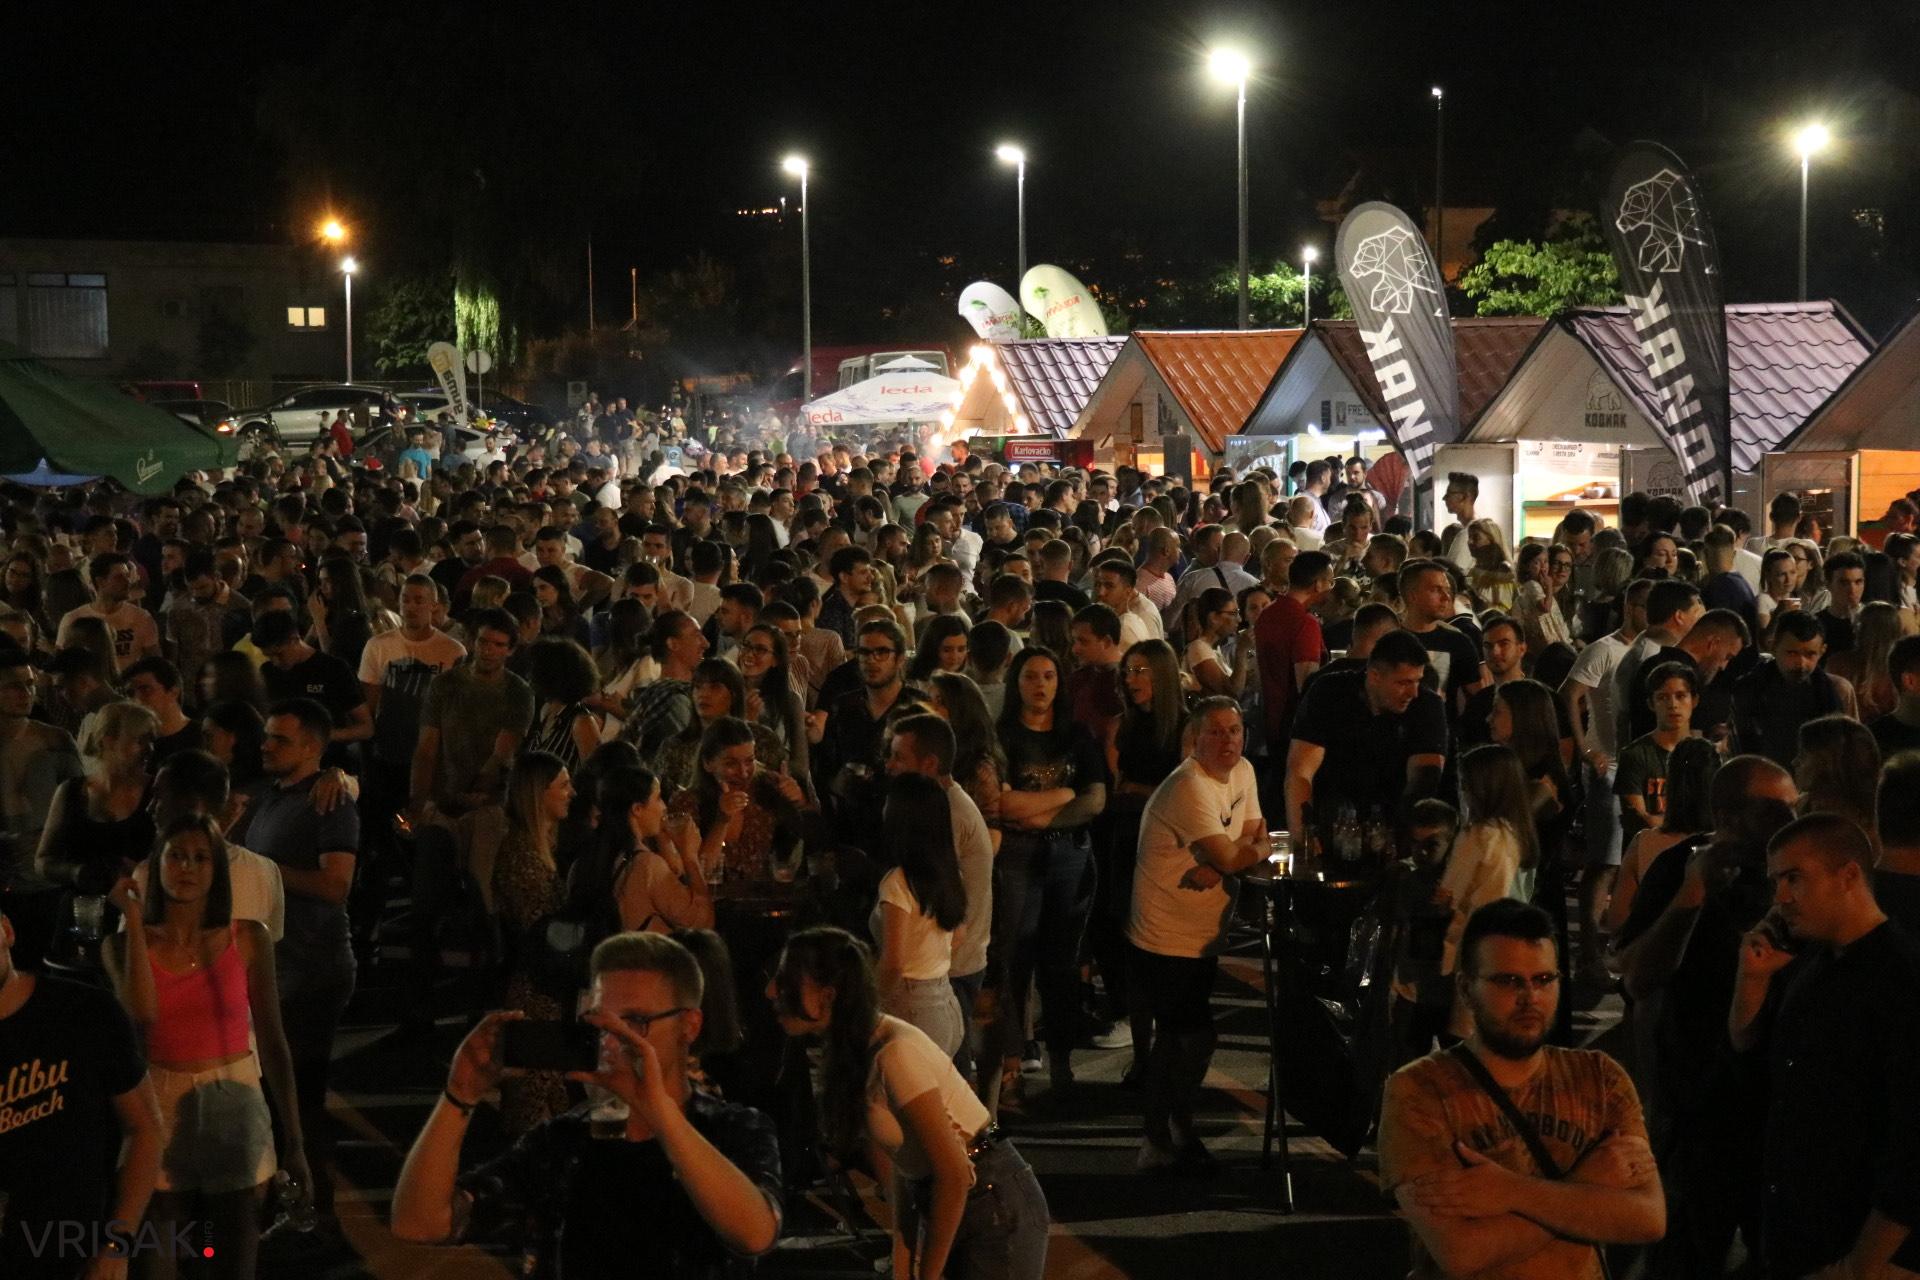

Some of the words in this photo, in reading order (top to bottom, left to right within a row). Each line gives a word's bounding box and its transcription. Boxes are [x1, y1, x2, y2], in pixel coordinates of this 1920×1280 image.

[880, 385, 933, 395] leda
[806, 409, 844, 425] leda
[0, 1088, 65, 1135] Beach
